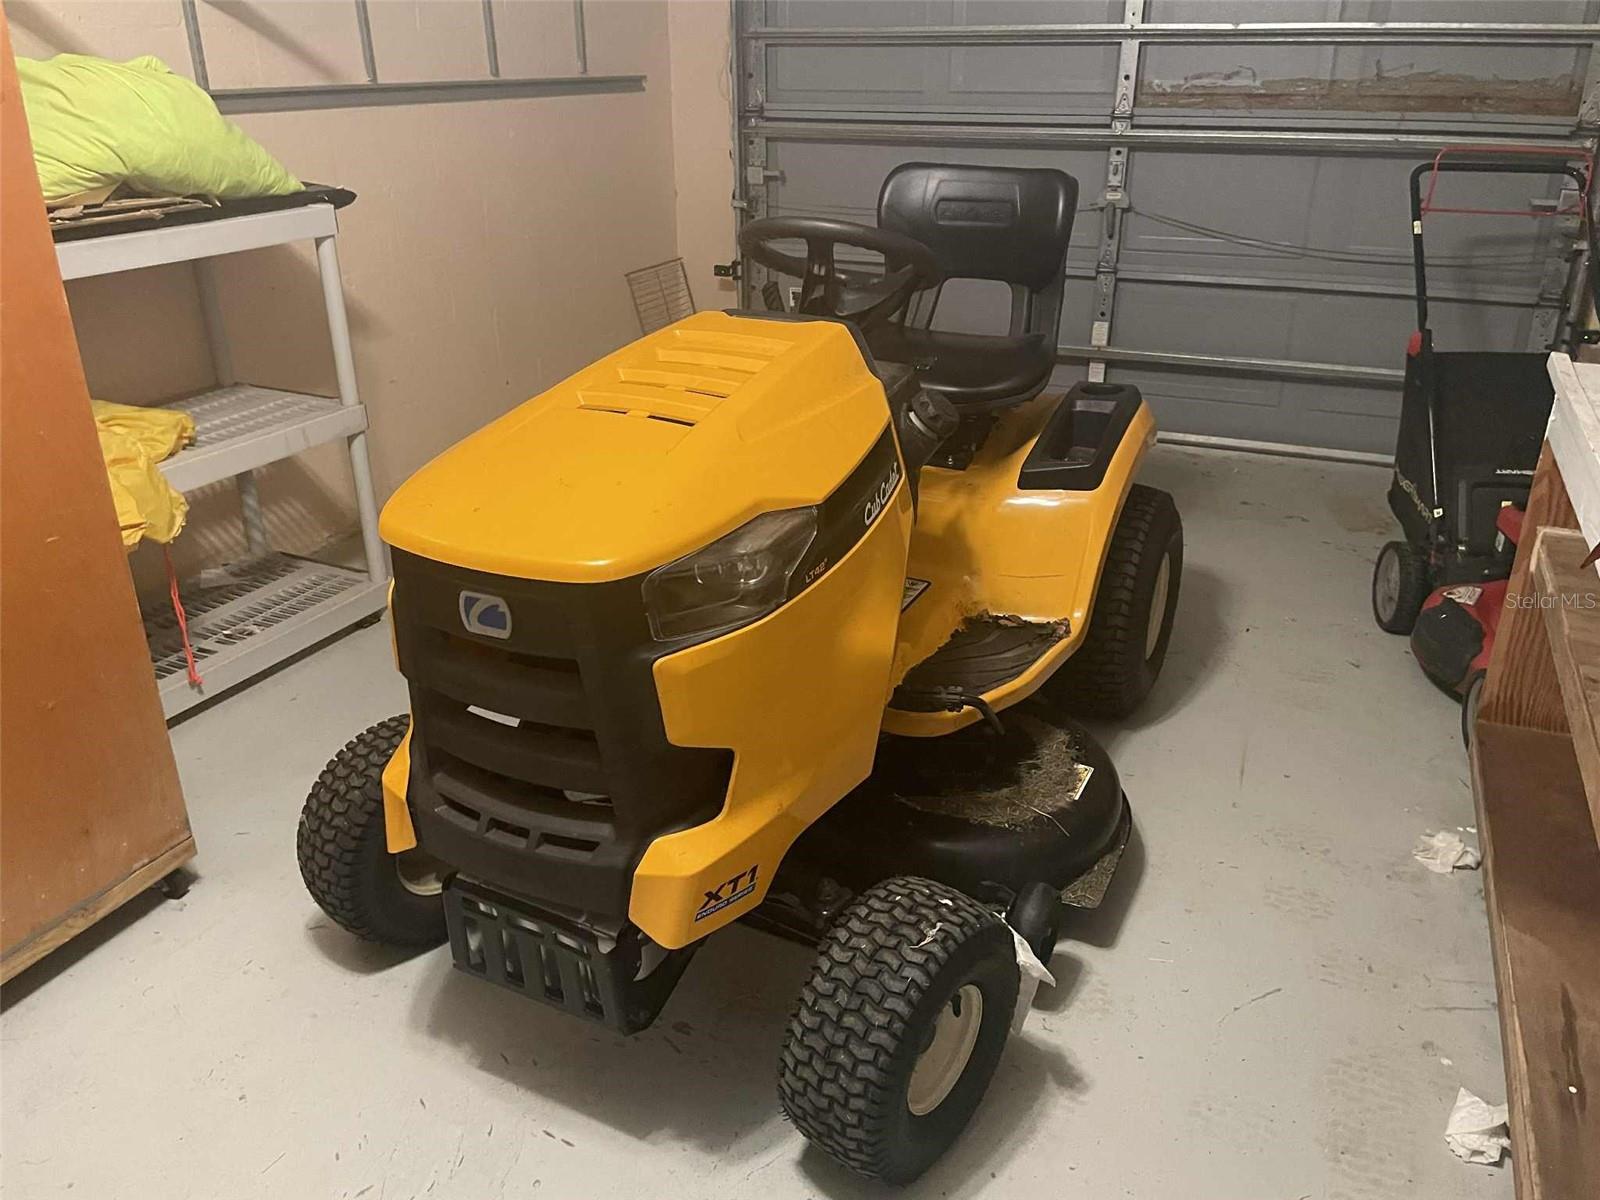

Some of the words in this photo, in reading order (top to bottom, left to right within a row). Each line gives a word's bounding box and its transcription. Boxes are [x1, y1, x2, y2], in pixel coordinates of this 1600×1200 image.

[864, 492, 881, 526] Cub
[880, 461, 900, 505] Cadet
[698, 864, 759, 912] XT1
